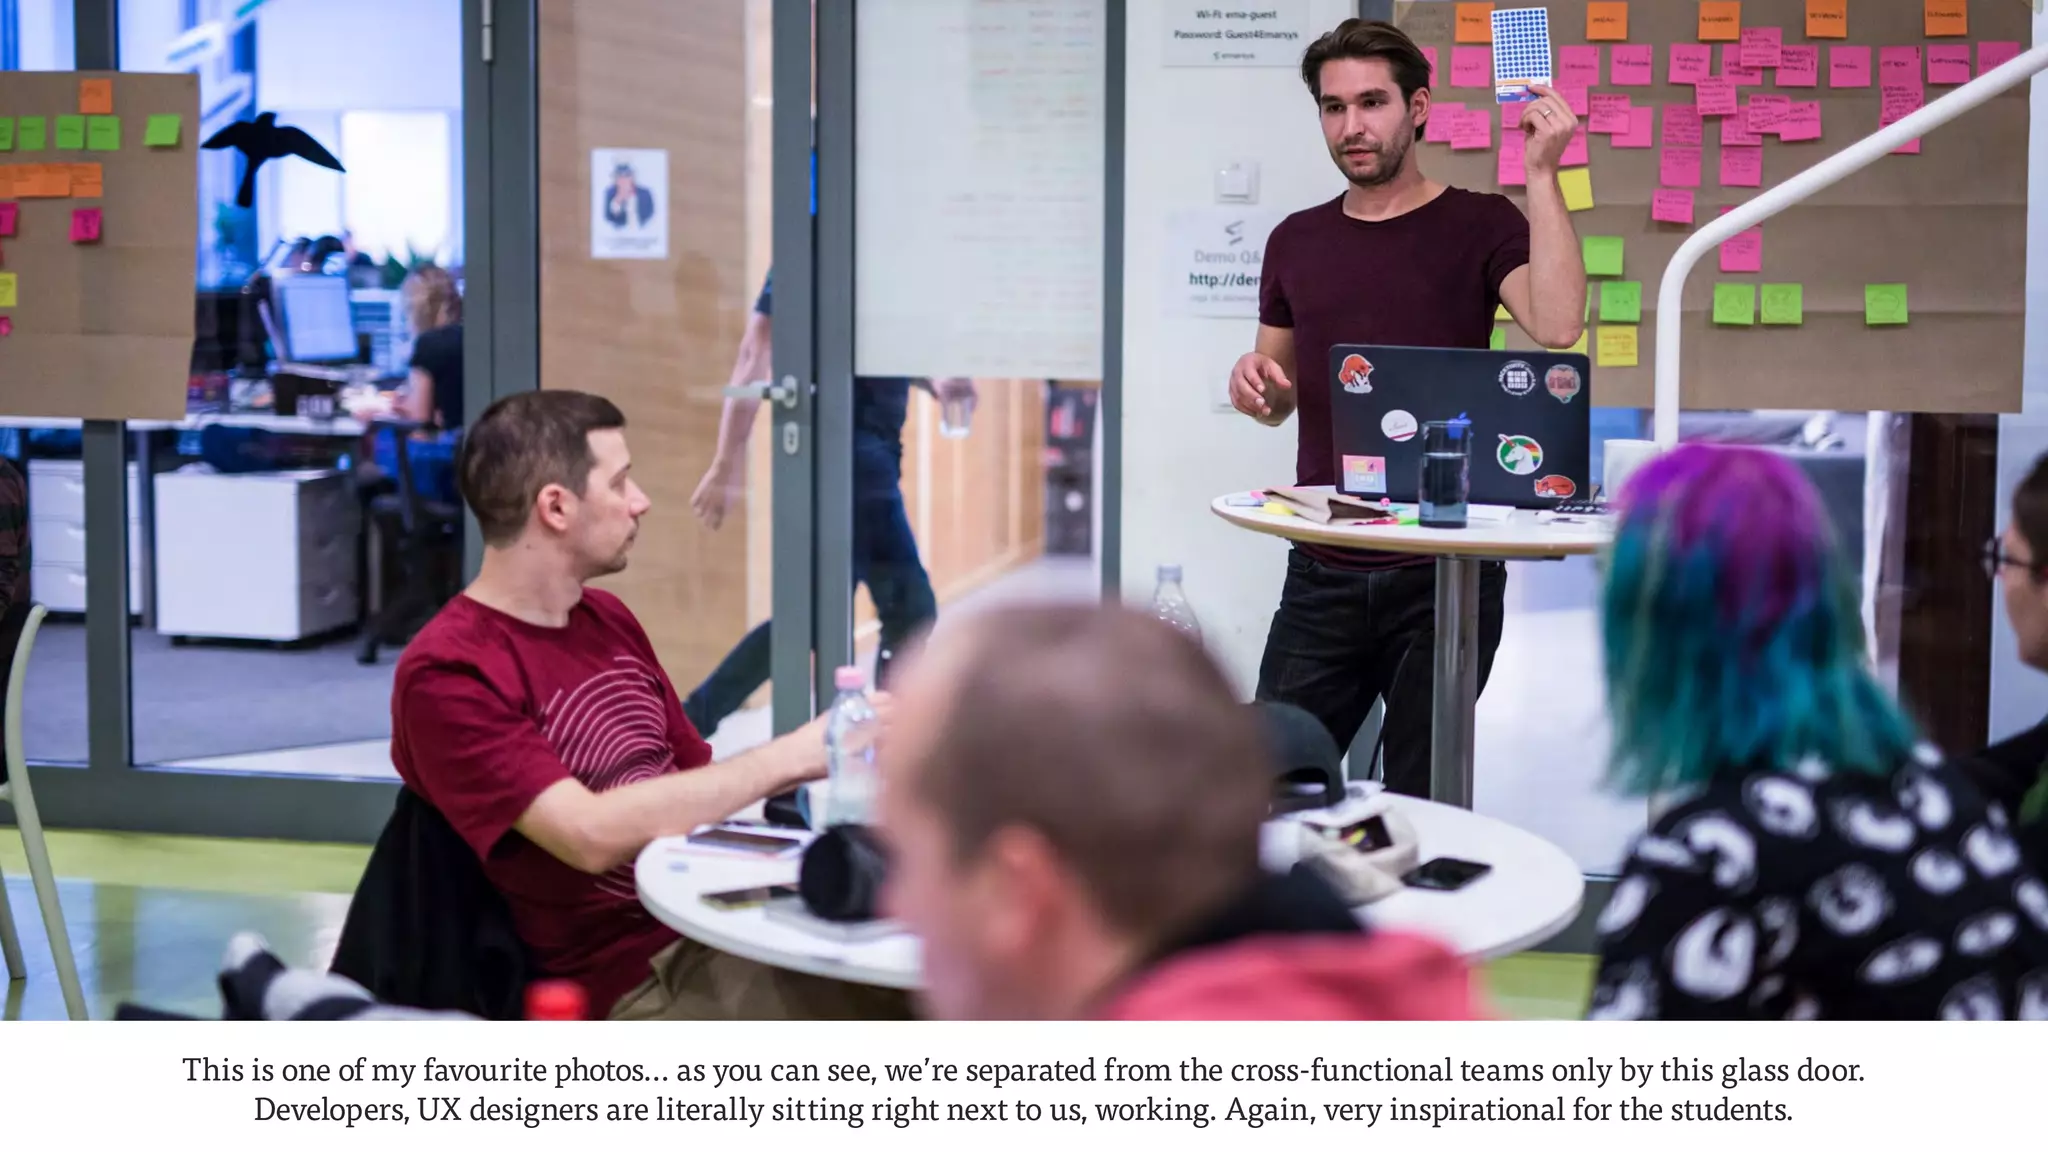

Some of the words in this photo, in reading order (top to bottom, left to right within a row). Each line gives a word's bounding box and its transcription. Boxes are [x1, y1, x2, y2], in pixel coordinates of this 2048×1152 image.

[1225, 10, 1277, 21] ema-guest
[1174, 30, 1222, 39] Password:
[1194, 250, 1236, 263] Demo
